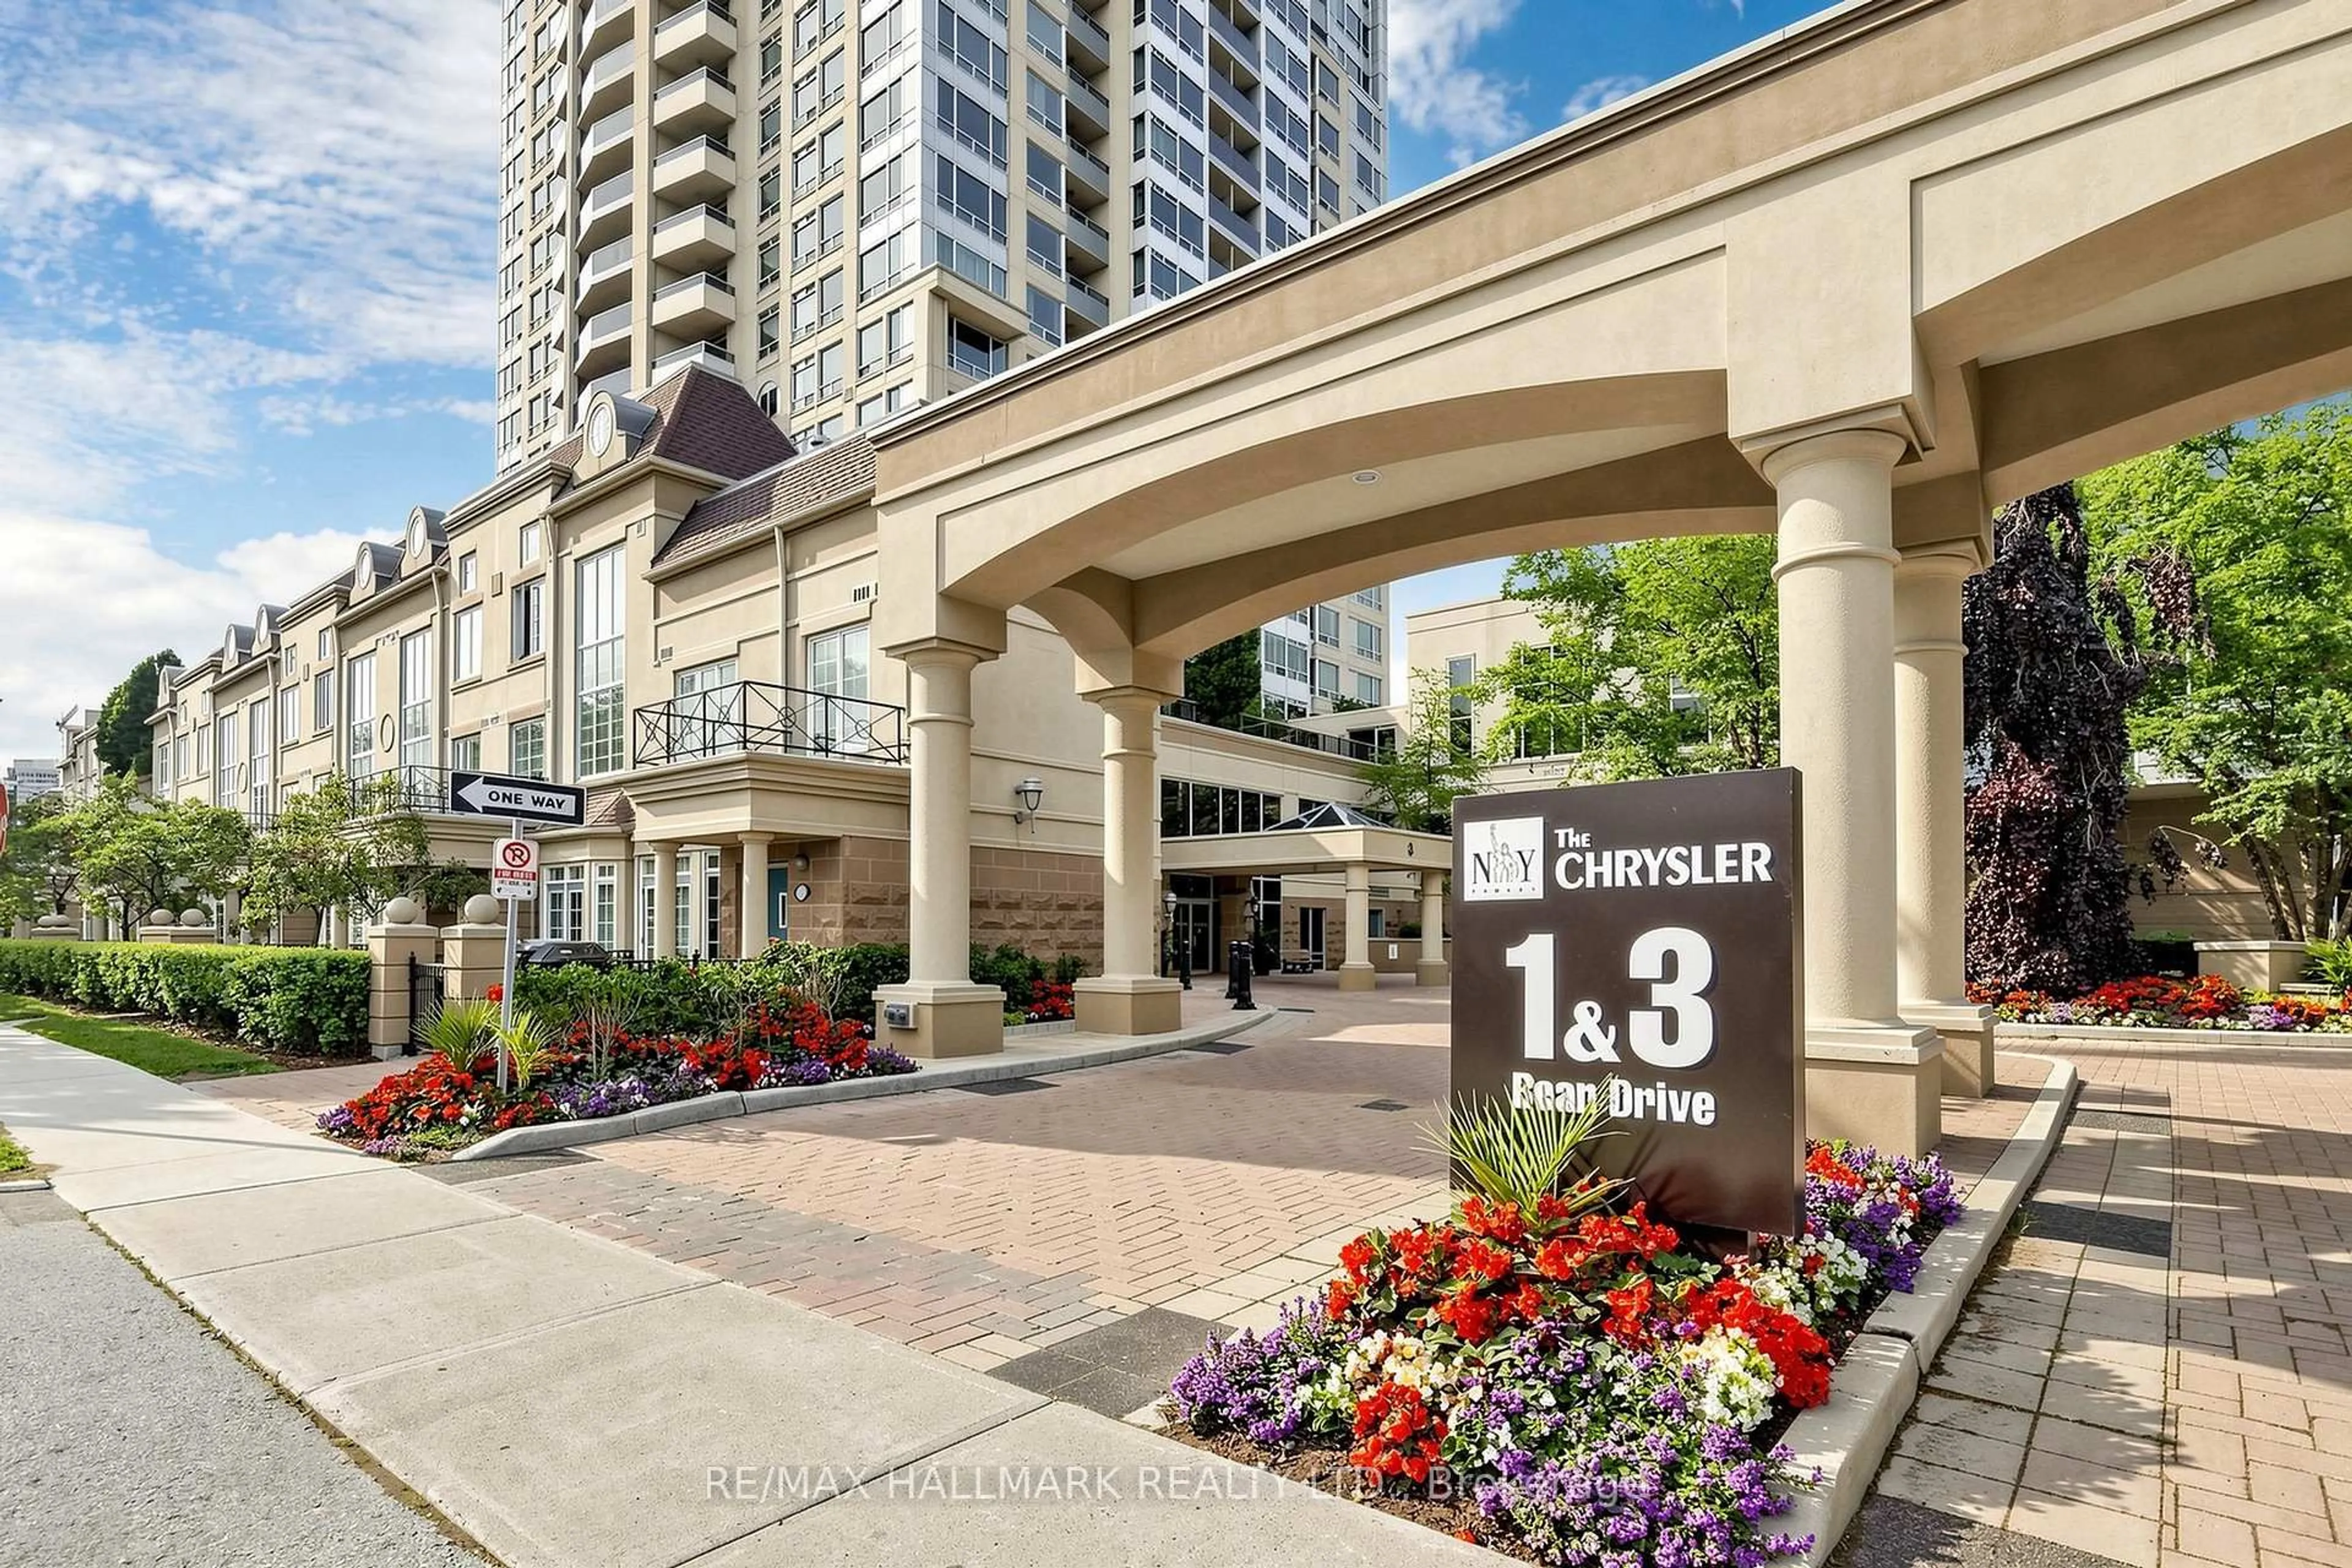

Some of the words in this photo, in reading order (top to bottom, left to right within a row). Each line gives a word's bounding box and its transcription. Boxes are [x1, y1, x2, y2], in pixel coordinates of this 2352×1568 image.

[489, 791, 523, 804] ONE
[531, 795, 565, 809] WAY
[1408, 842, 1414, 856] 3
[1555, 842, 1774, 890] CHRYSLER
[1610, 1079, 1716, 1126] Drive
